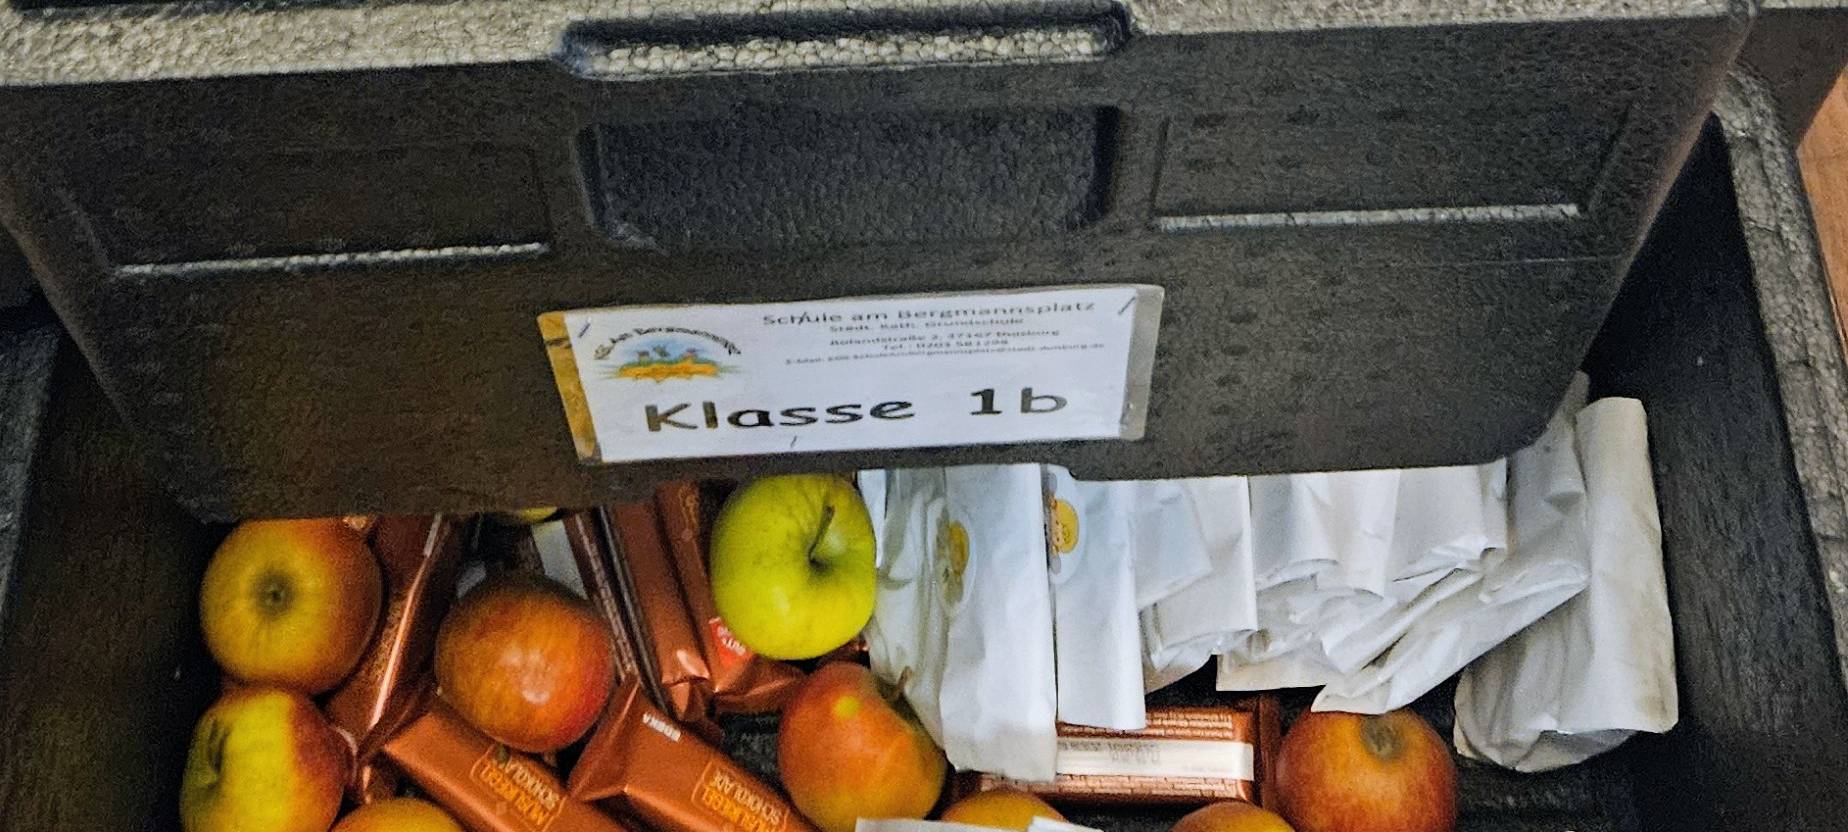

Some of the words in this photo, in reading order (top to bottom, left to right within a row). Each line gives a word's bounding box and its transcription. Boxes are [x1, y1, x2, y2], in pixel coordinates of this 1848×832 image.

[763, 311, 842, 325] Schule
[852, 313, 888, 321] am
[898, 302, 1095, 320] Bergmannsplatz
[645, 400, 916, 432] Klasse
[969, 387, 1068, 416] 1b
